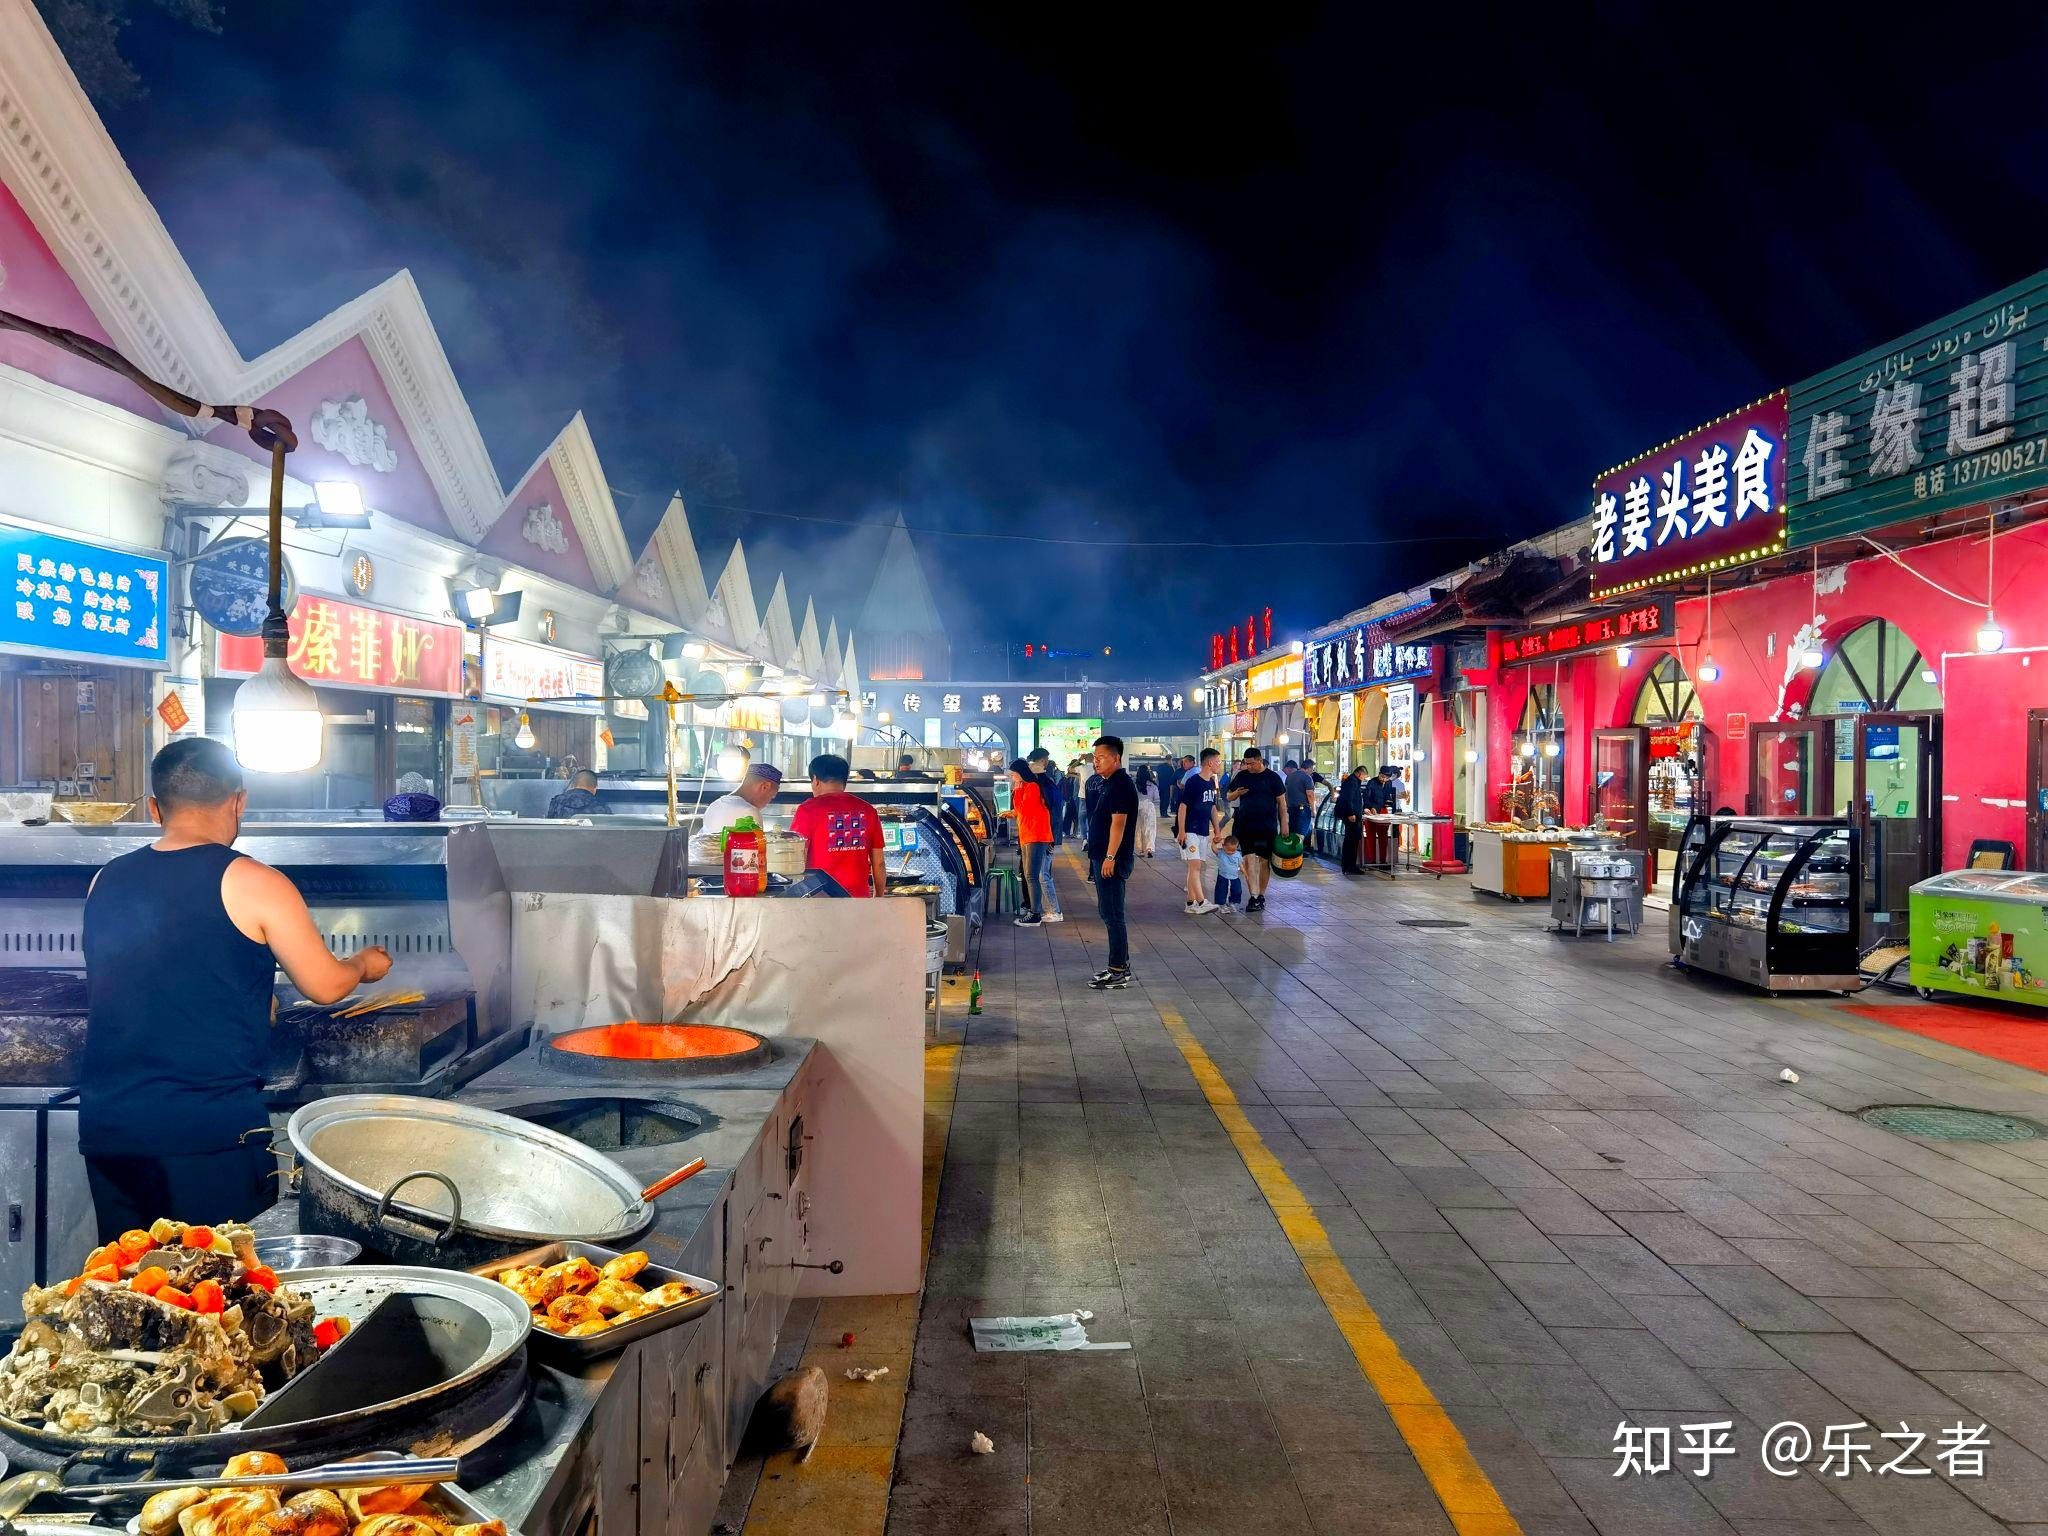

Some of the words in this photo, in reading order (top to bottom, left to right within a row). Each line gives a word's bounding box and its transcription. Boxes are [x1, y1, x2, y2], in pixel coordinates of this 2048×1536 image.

[1802, 337, 2048, 501] 佳缘超
[1914, 464, 1947, 499] 电话
[1953, 438, 2048, 486] 137790527
[1591, 429, 1773, 562] 老姜头美食
[16, 577, 73, 605] 冷水鱼
[17, 552, 132, 593] 民族特色烧烤
[82, 611, 131, 636] 格瓦斯
